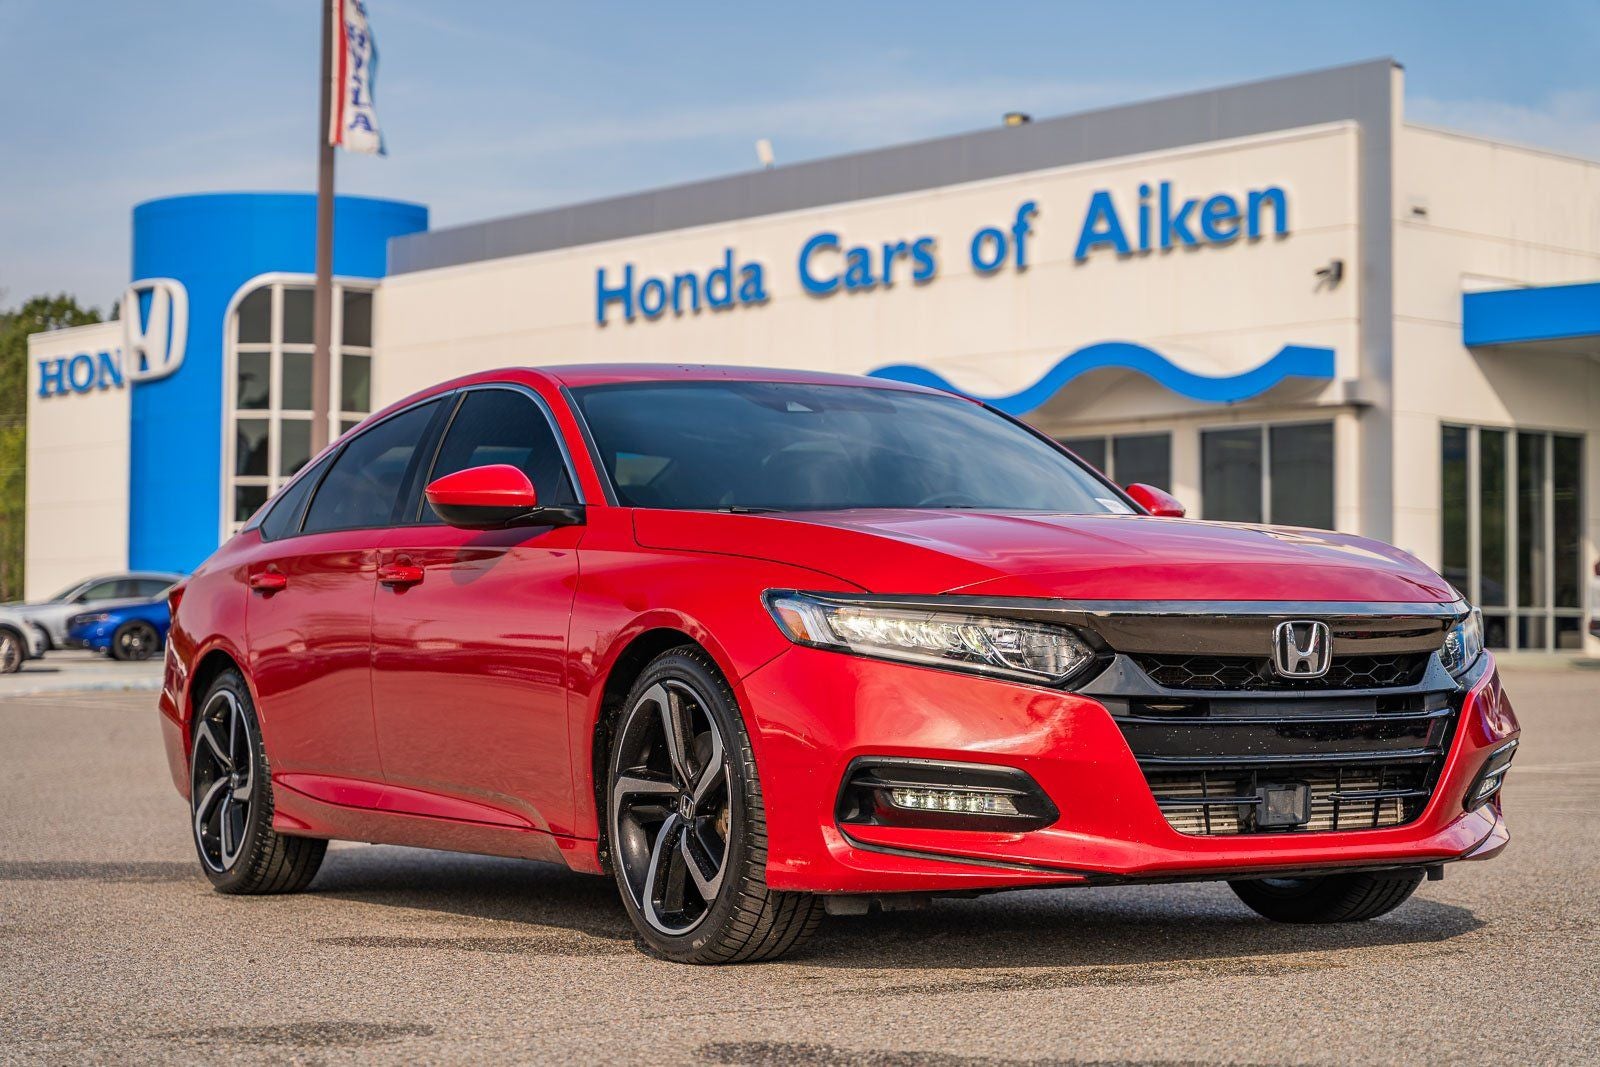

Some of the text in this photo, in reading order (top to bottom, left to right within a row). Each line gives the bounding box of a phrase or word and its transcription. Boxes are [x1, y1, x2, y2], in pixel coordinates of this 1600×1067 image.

[596, 181, 1291, 325] Honda Cars of Aiken
